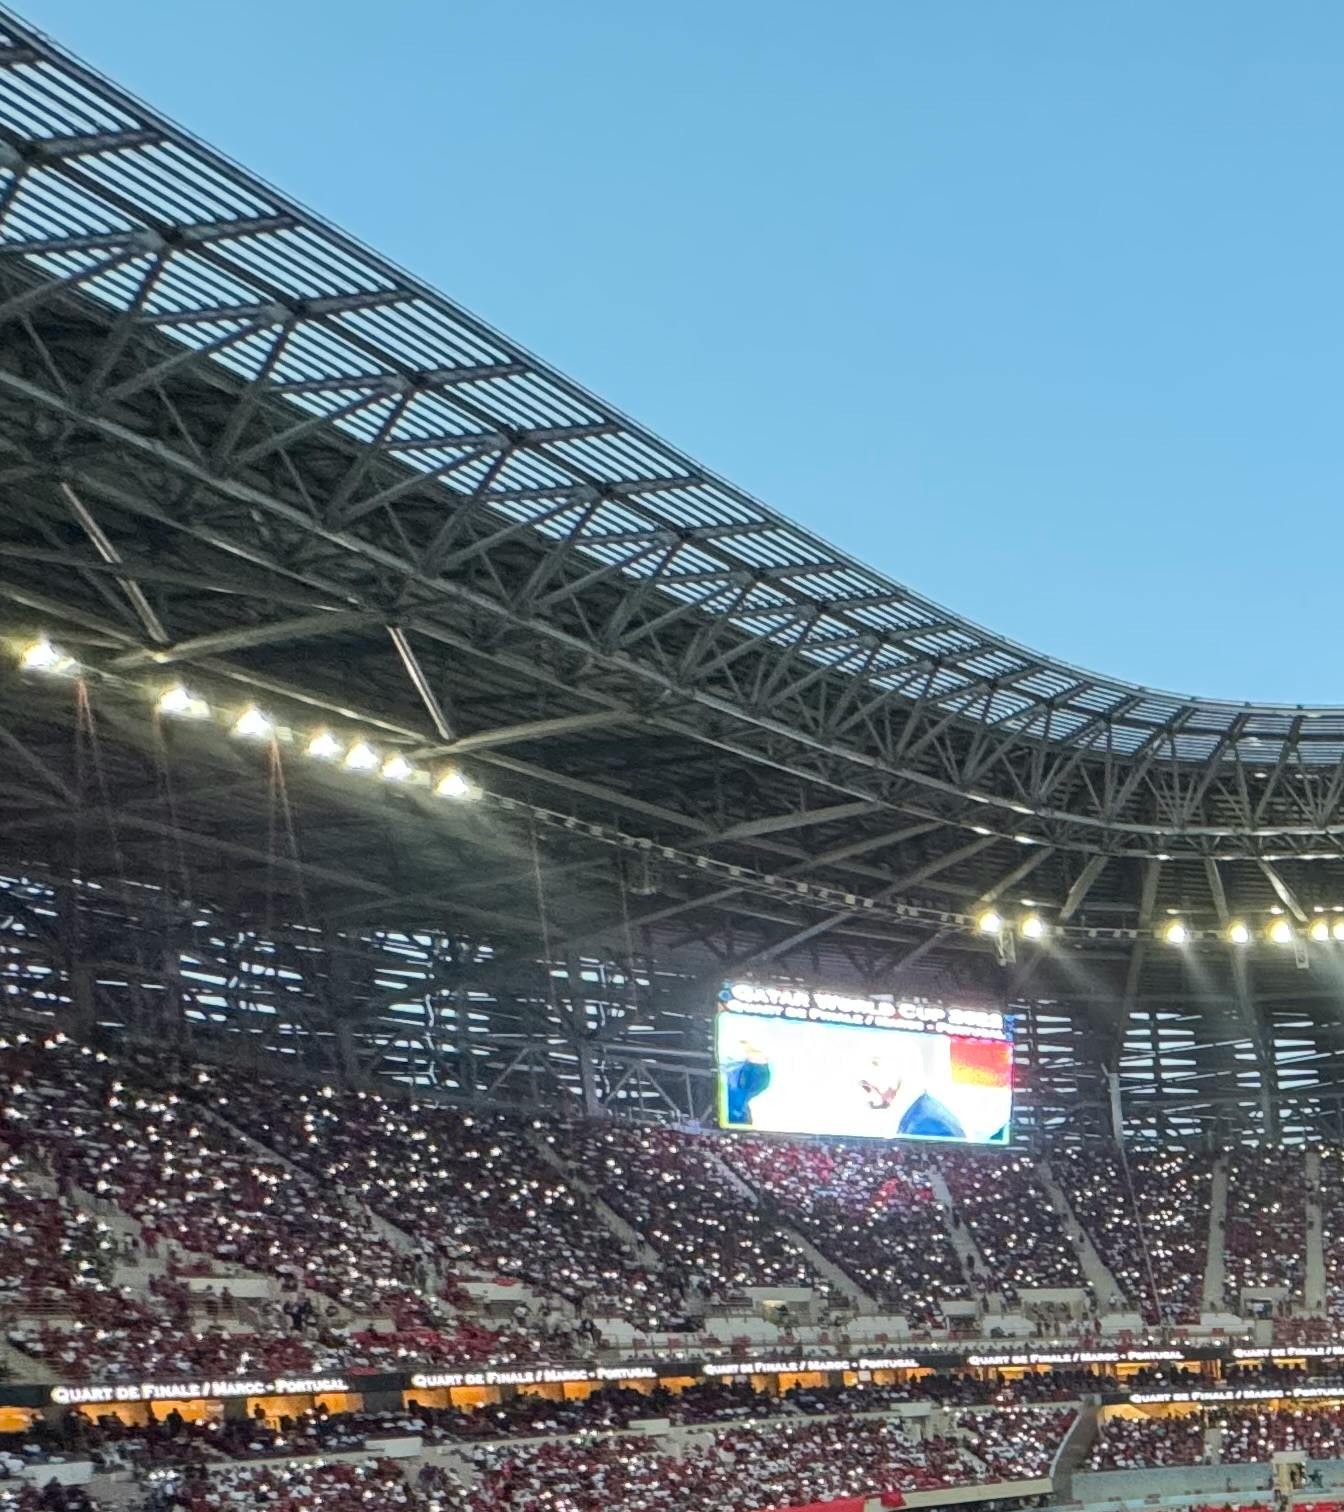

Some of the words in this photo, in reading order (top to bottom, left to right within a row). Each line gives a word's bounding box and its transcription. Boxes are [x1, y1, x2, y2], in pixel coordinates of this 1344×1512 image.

[899, 1001, 946, 1021] CUP
[411, 1374, 463, 1387] QUART
[464, 1374, 485, 1384] DE
[486, 1372, 534, 1384] FINALE
[543, 1369, 587, 1381] MAROC
[596, 1368, 656, 1379] PORTUGAL
[51, 1387, 113, 1403] QUART
[115, 1386, 139, 1400] DE
[142, 1384, 200, 1398] FINALE
[210, 1381, 264, 1396] MAROC
[274, 1379, 348, 1392] PORTUGAL
